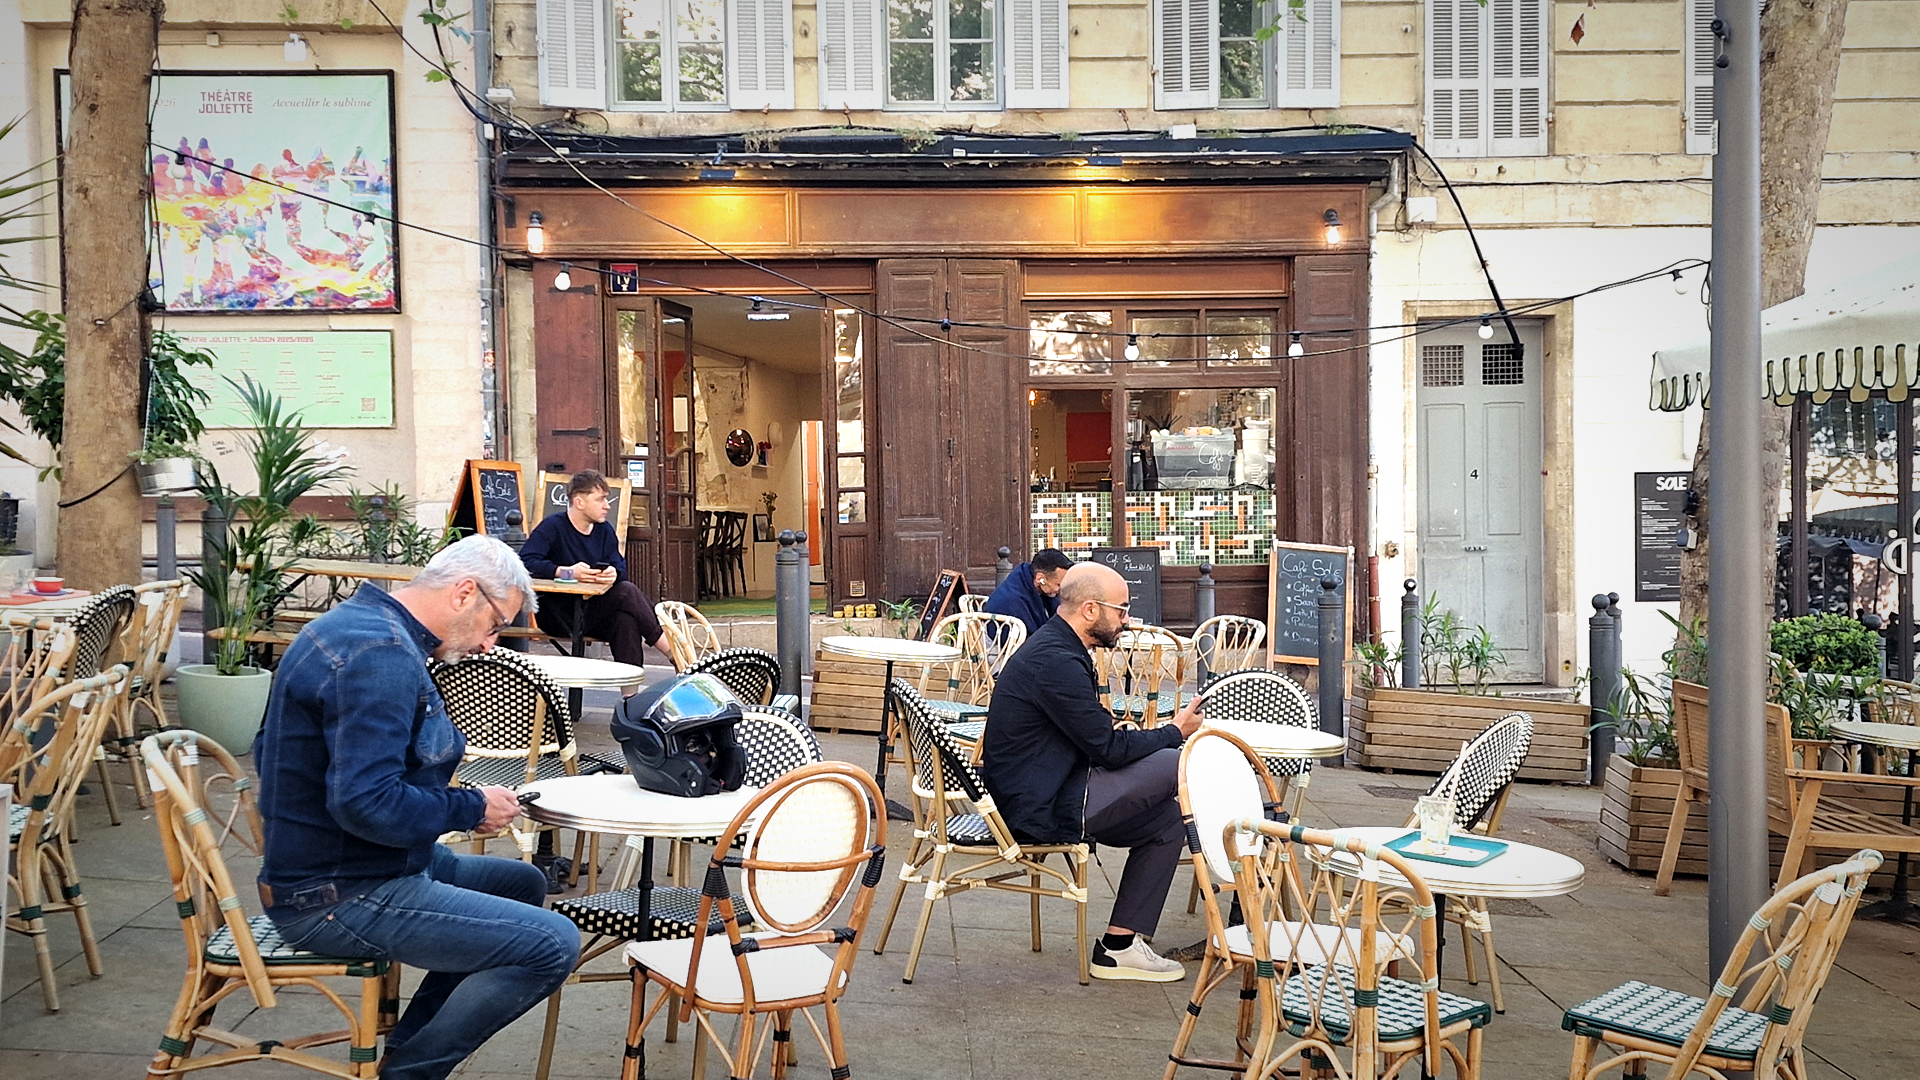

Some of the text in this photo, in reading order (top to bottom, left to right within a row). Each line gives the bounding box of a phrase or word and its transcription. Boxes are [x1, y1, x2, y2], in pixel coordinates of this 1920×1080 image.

[200, 89, 253, 102] THÉÂTRE
[272, 97, 373, 108] Accueillir le sublime
[199, 103, 253, 114] JOLIETTE
[1469, 468, 1479, 480] 4
